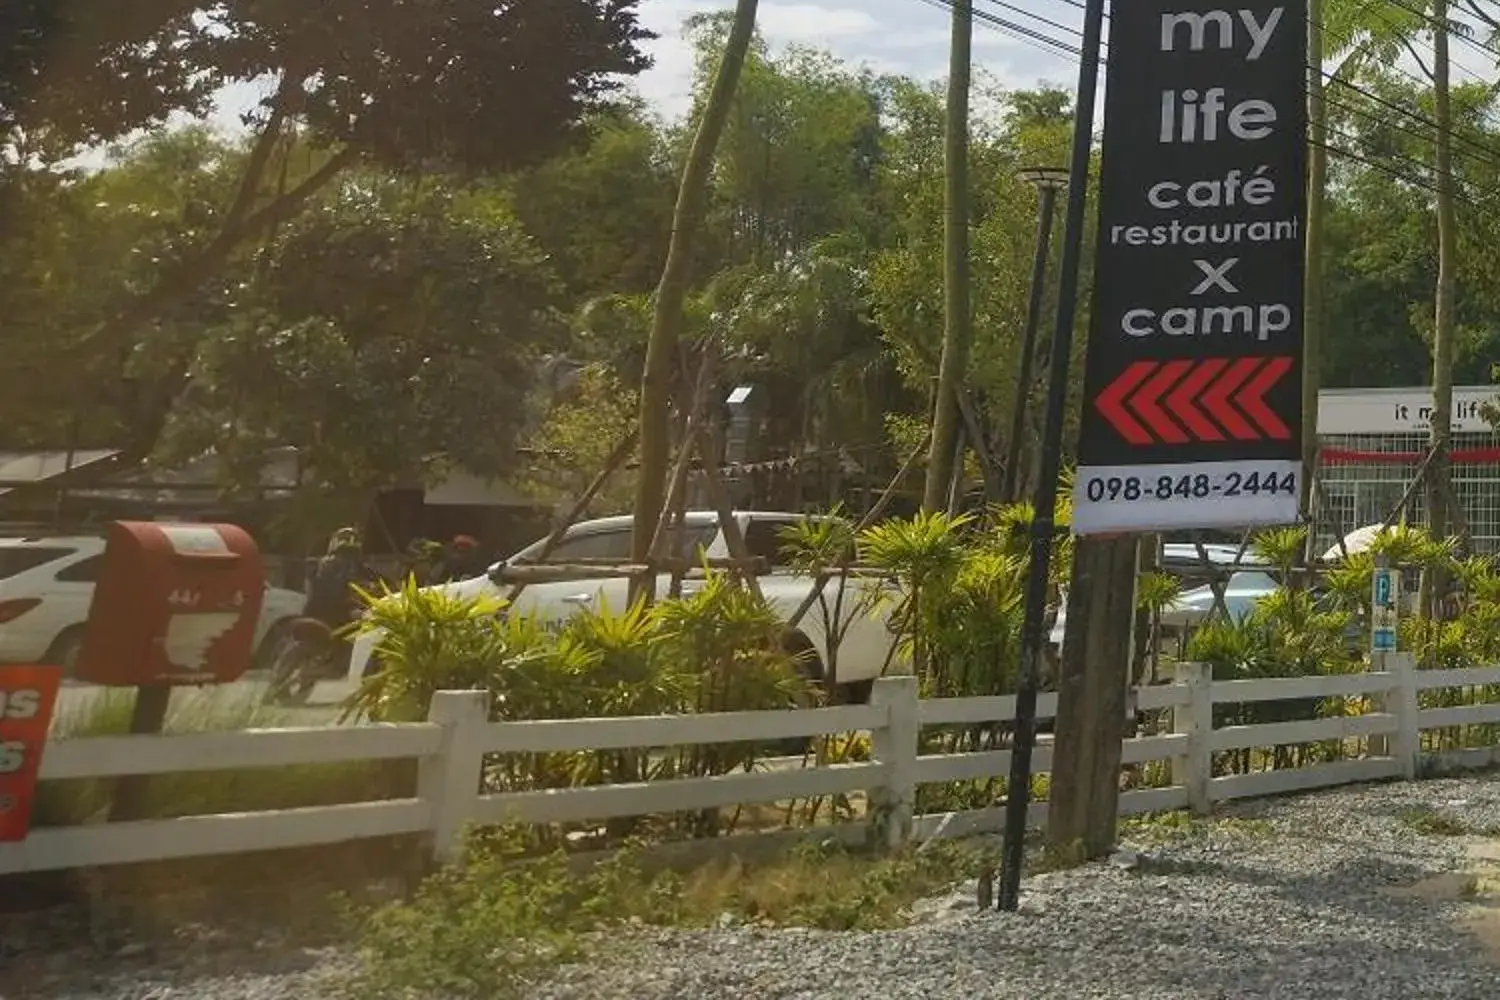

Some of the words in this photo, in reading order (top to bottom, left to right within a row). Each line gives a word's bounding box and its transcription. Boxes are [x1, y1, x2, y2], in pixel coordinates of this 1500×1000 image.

[1160, 6, 1284, 61] my
[1159, 87, 1277, 143] life
[1148, 165, 1275, 210] café
[1121, 303, 1291, 341] camp
[1086, 471, 1296, 503] 098-848-2444
